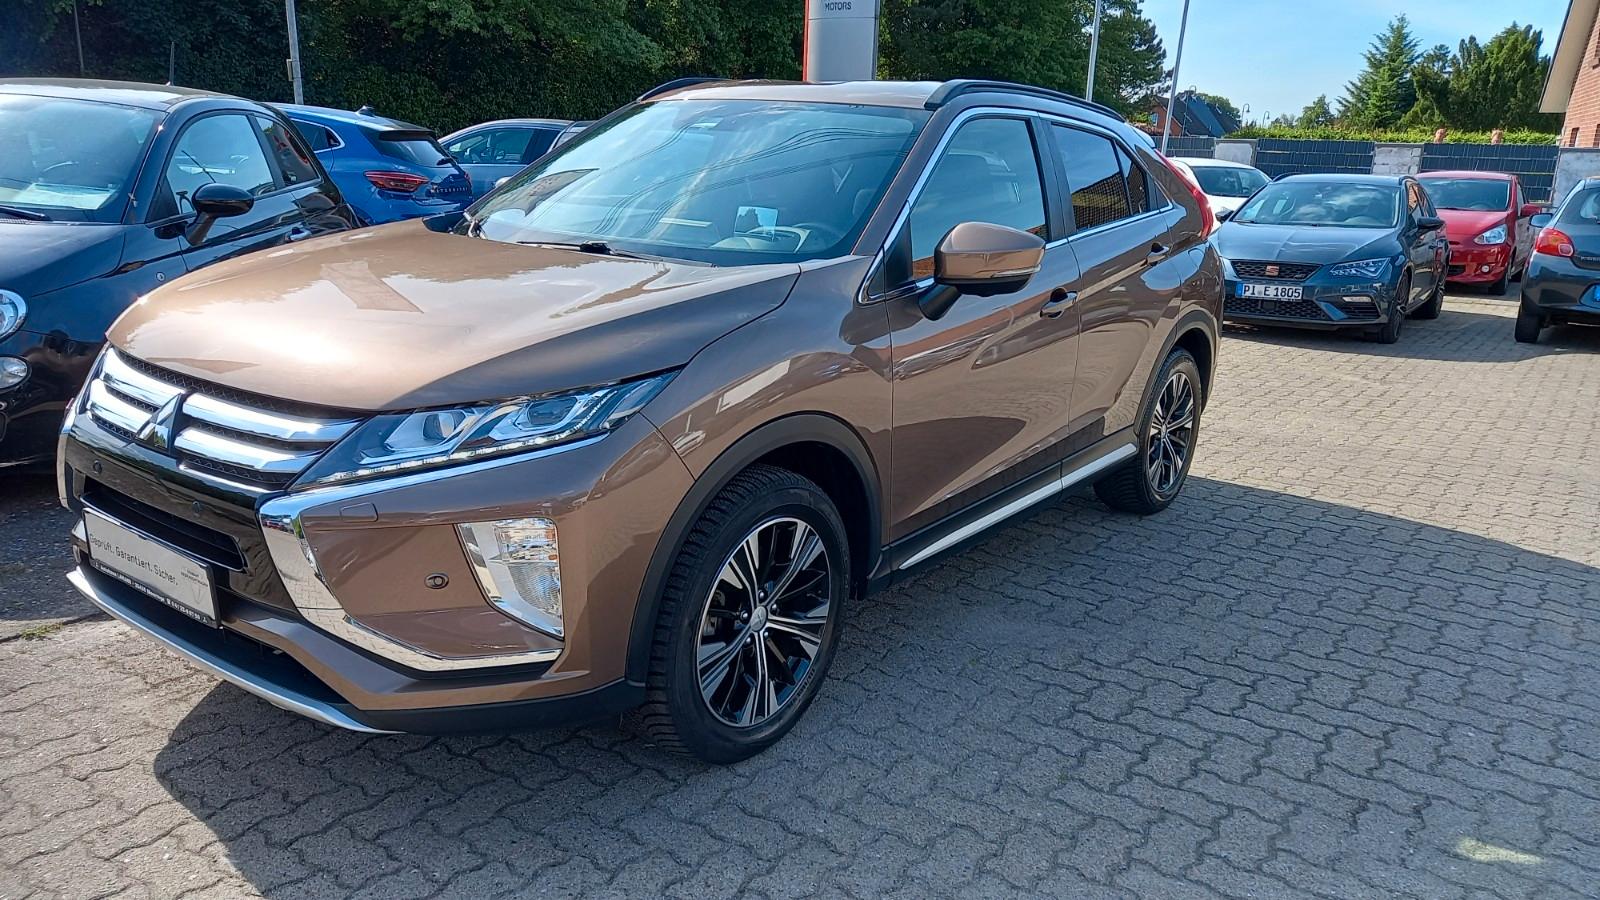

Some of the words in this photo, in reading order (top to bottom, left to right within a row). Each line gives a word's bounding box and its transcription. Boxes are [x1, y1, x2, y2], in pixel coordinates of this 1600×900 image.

[825, 1, 852, 11] MOTORS
[1243, 285, 1256, 296] PI
[1264, 286, 1271, 297] E
[1273, 287, 1301, 298] 1805
[115, 546, 153, 573] Garantiert.
[154, 564, 179, 586] Sicher.
